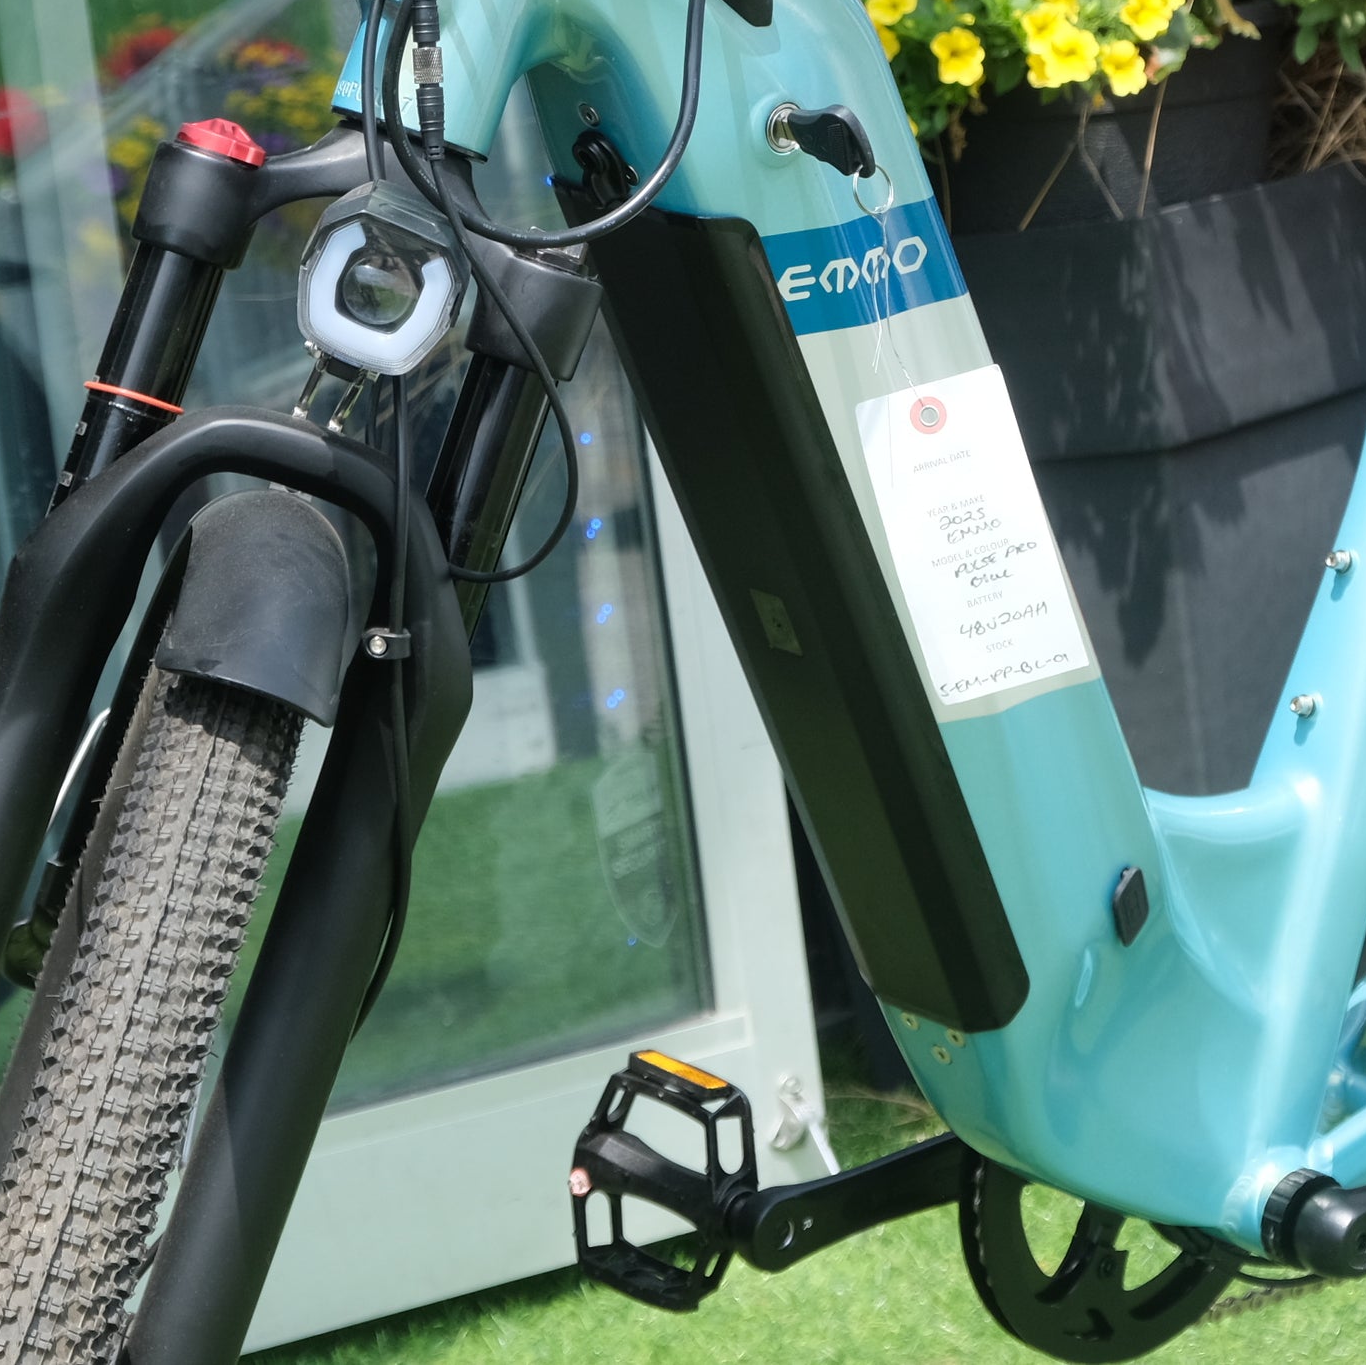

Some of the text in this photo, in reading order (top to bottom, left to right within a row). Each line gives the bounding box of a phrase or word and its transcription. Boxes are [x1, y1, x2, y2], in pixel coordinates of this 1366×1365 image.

[777, 235, 928, 302] EMMO
[913, 449, 971, 474] ARRIVAL DATE
[926, 505, 949, 518] YEAR
[959, 494, 985, 508] MAKE
[939, 507, 986, 531] 2025
[931, 552, 965, 568] MODEL
[973, 537, 1010, 555] COLOUR
[966, 590, 1003, 608] BATTERY
[985, 638, 1014, 654] STOCK
